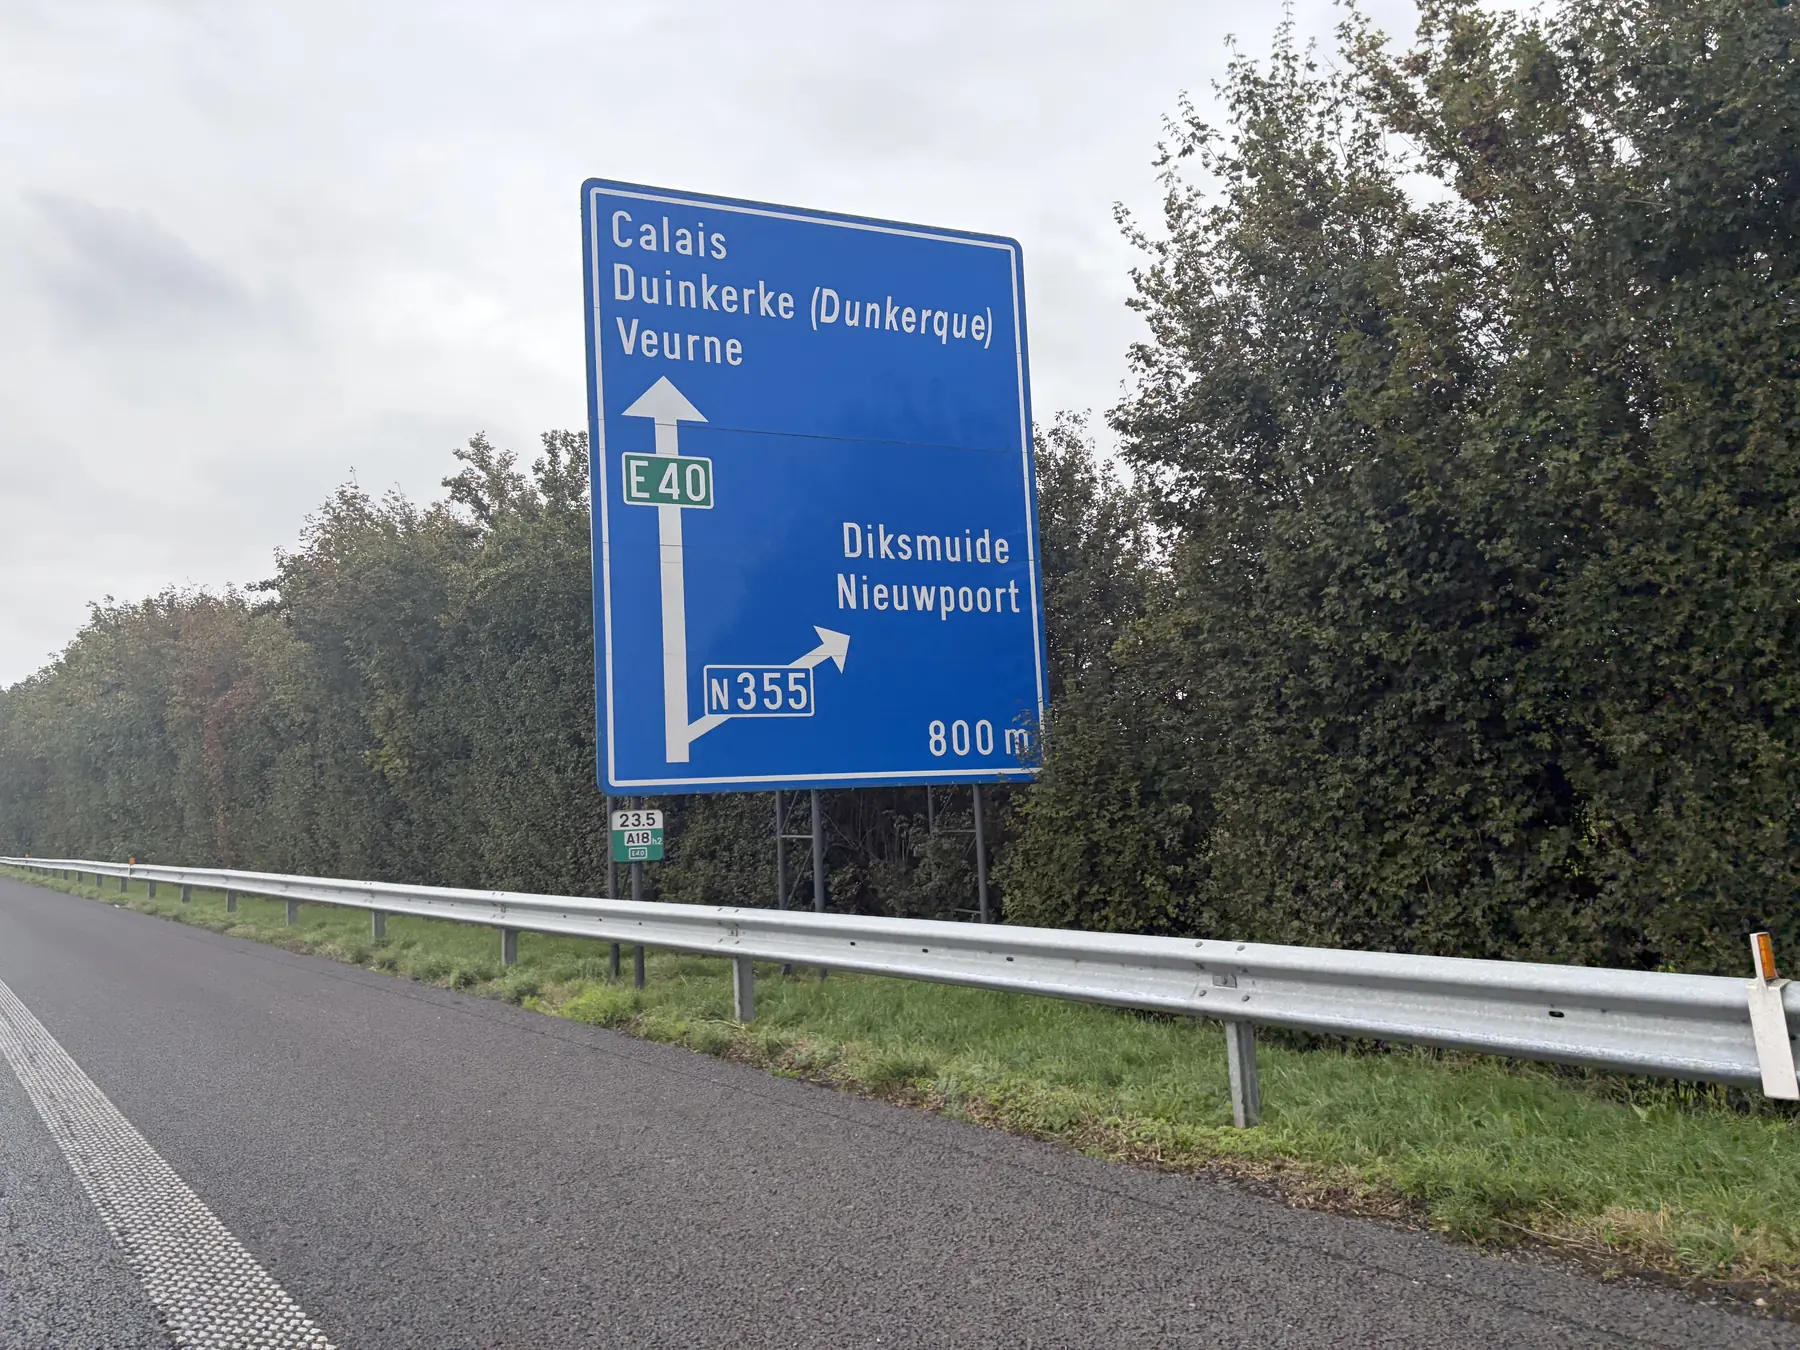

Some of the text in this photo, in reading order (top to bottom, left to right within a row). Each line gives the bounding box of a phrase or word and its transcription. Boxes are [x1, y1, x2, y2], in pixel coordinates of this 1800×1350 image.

[612, 210, 727, 260] Calais
[613, 263, 993, 350] Duinkerke (Dunkerque)
[616, 316, 743, 366] Veurne
[843, 522, 1010, 564] Diksmuide
[837, 573, 1020, 621] Nieuwpoort
[928, 719, 1029, 757] 800 m
[619, 812, 656, 828] 23.5
[626, 832, 650, 845] A18
